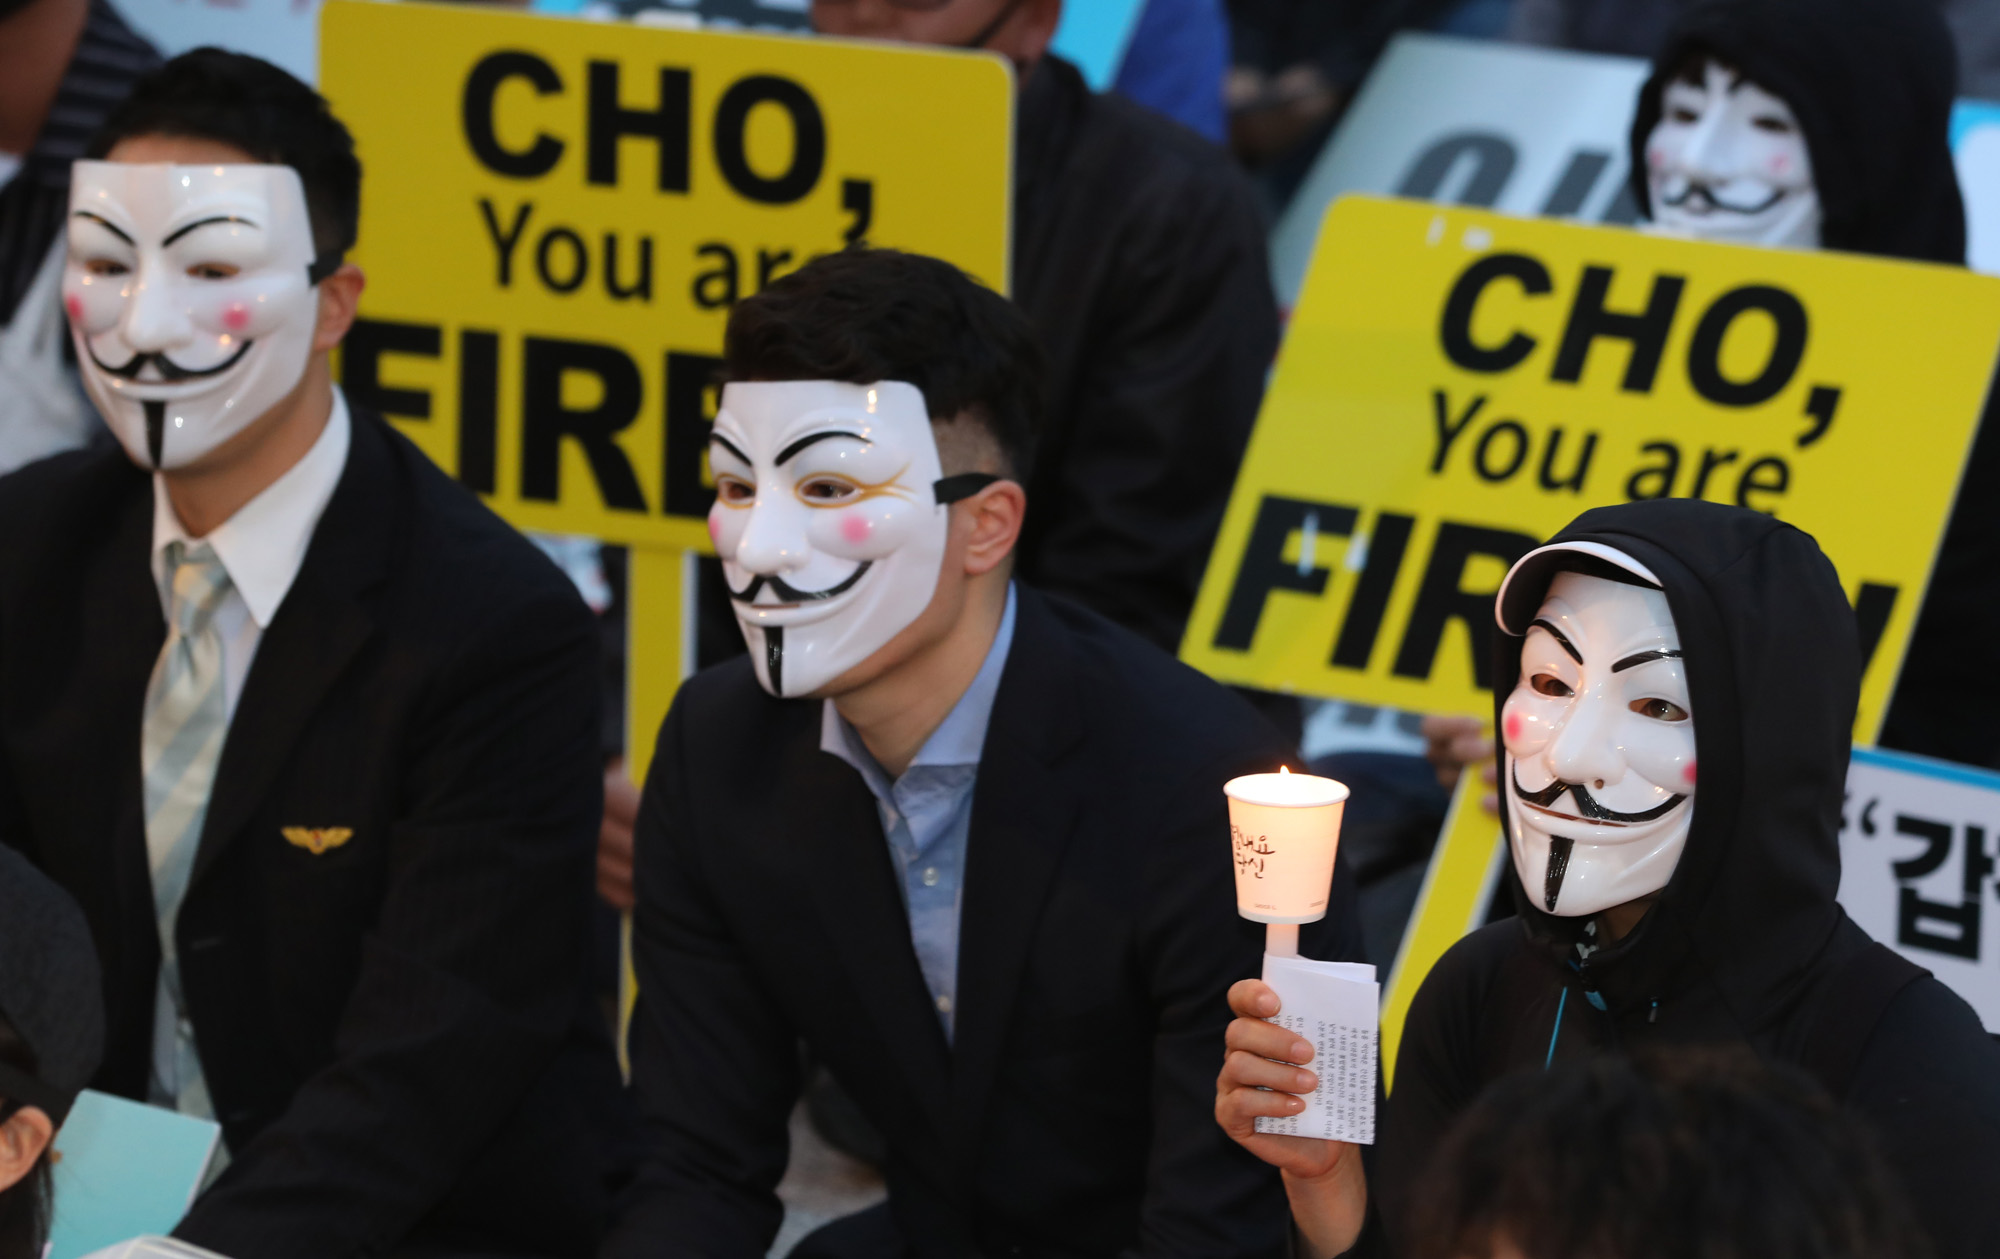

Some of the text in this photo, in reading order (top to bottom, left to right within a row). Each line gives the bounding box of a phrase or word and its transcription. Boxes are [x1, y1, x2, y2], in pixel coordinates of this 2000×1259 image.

[461, 48, 873, 242] CHO,
[478, 198, 802, 310] You ar
[1438, 252, 1843, 448] CHO,
[1430, 389, 1791, 516] You are
